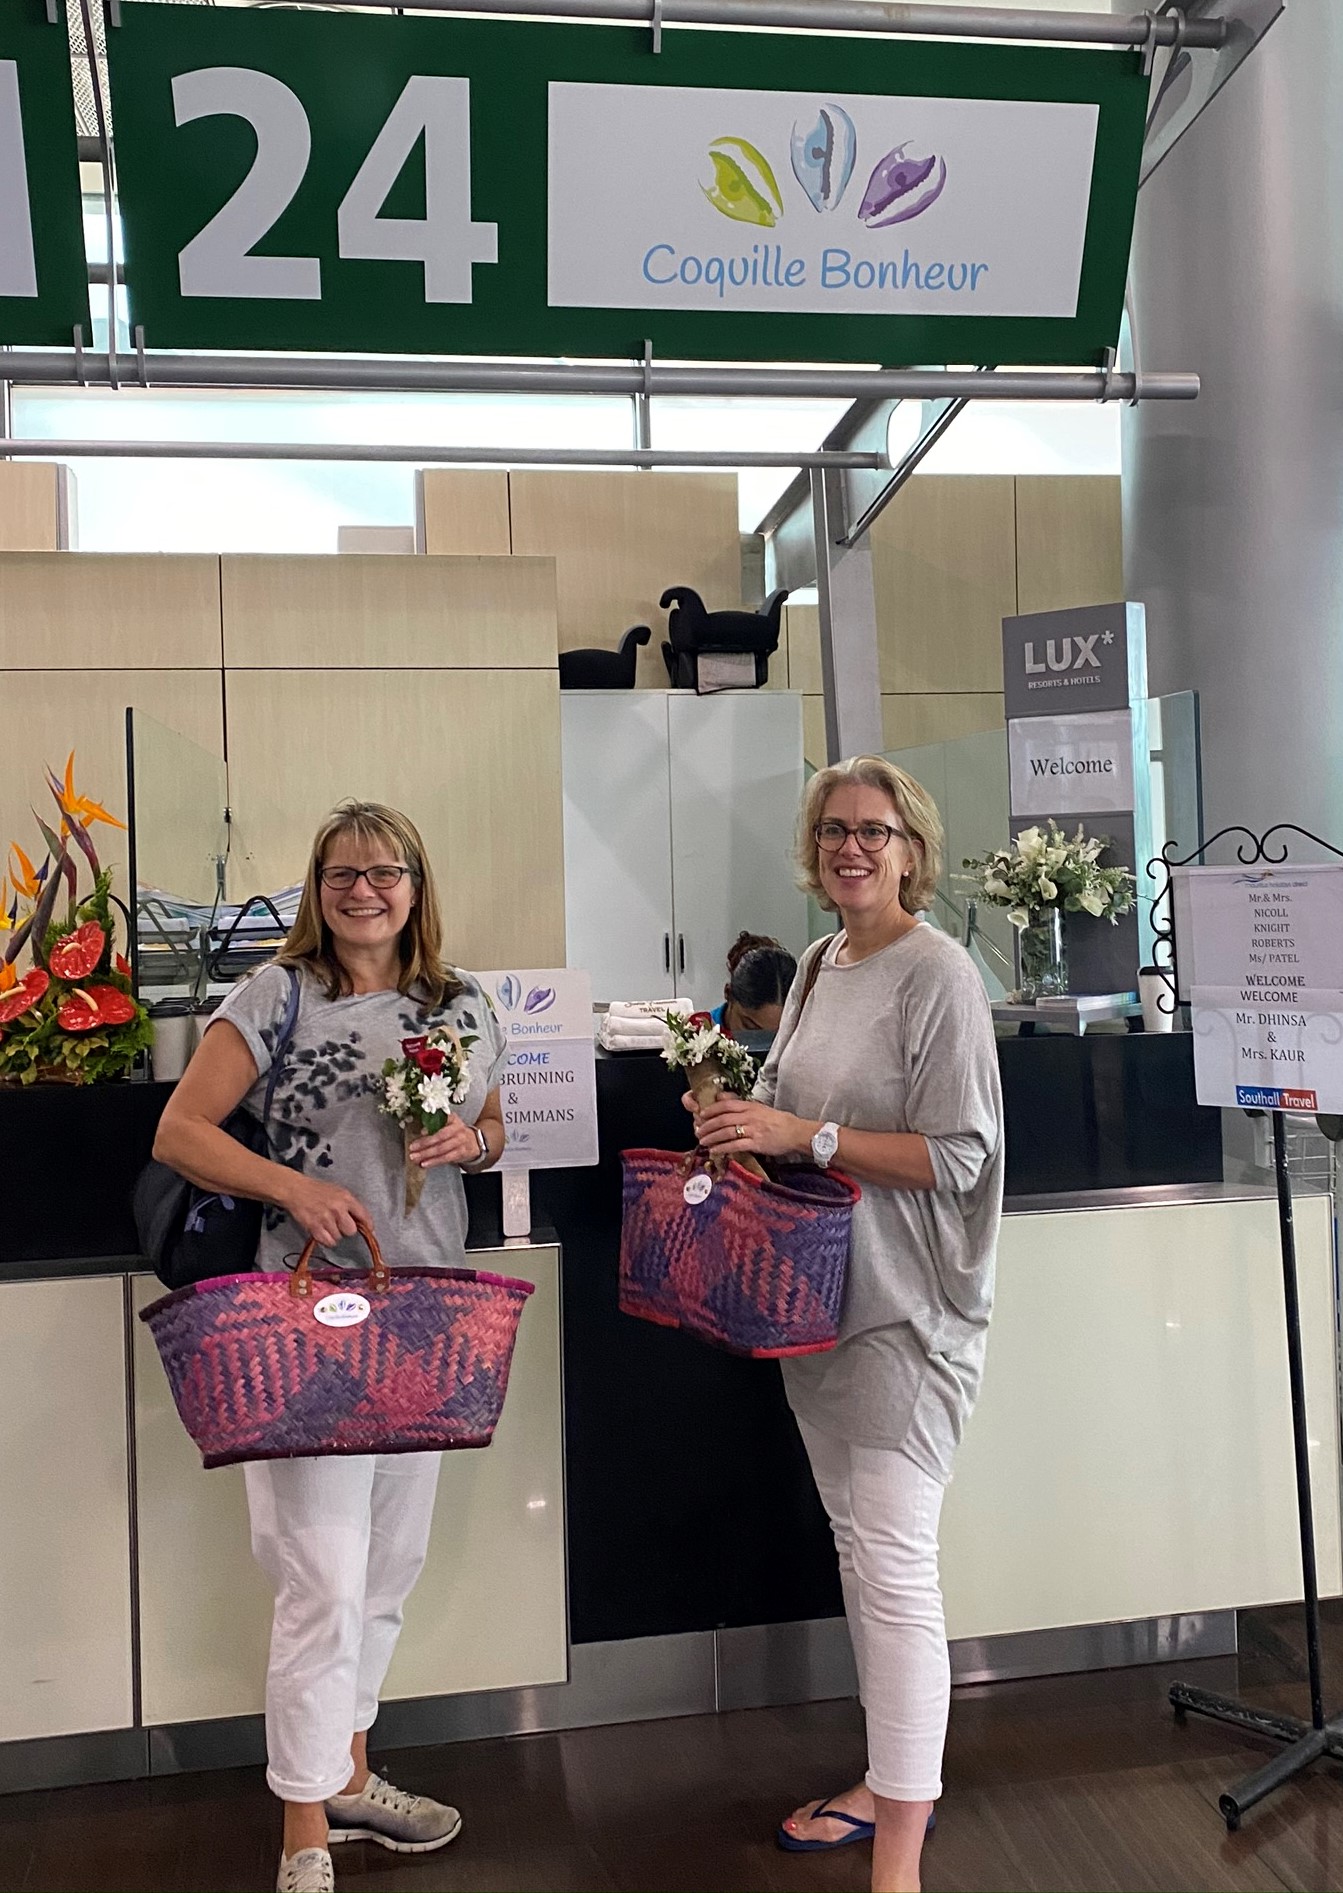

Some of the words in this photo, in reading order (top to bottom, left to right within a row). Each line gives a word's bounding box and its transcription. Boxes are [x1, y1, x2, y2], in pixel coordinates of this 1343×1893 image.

[171, 66, 498, 303] 24
[642, 244, 805, 297] Coquille
[821, 247, 989, 291] Bonheur
[1028, 680, 1062, 690] RESORTS
[1071, 675, 1101, 685] HOTELS
[1031, 757, 1113, 776] Welcome
[1272, 893, 1293, 902] Mrs.
[1254, 908, 1289, 918] NICOLL
[1254, 923, 1291, 933] KNIGHT
[1251, 938, 1295, 948] ROBERTS
[1249, 953, 1266, 964] Ms/
[1269, 953, 1300, 963] PATEL
[1246, 974, 1306, 987] WELCOME
[1240, 990, 1299, 1003] WELCOME
[1236, 1012, 1256, 1024] Mr.
[1258, 1013, 1307, 1027] DHINSA
[511, 1022, 563, 1035] Bonheur
[1267, 1031, 1277, 1043] &
[1241, 1047, 1267, 1060] Mrs.
[1270, 1048, 1306, 1062] KAUR
[507, 1092, 518, 1105] &
[1239, 1089, 1280, 1106] Southall
[1282, 1092, 1315, 1109] Travel
[505, 1109, 574, 1124] SIMMANS
